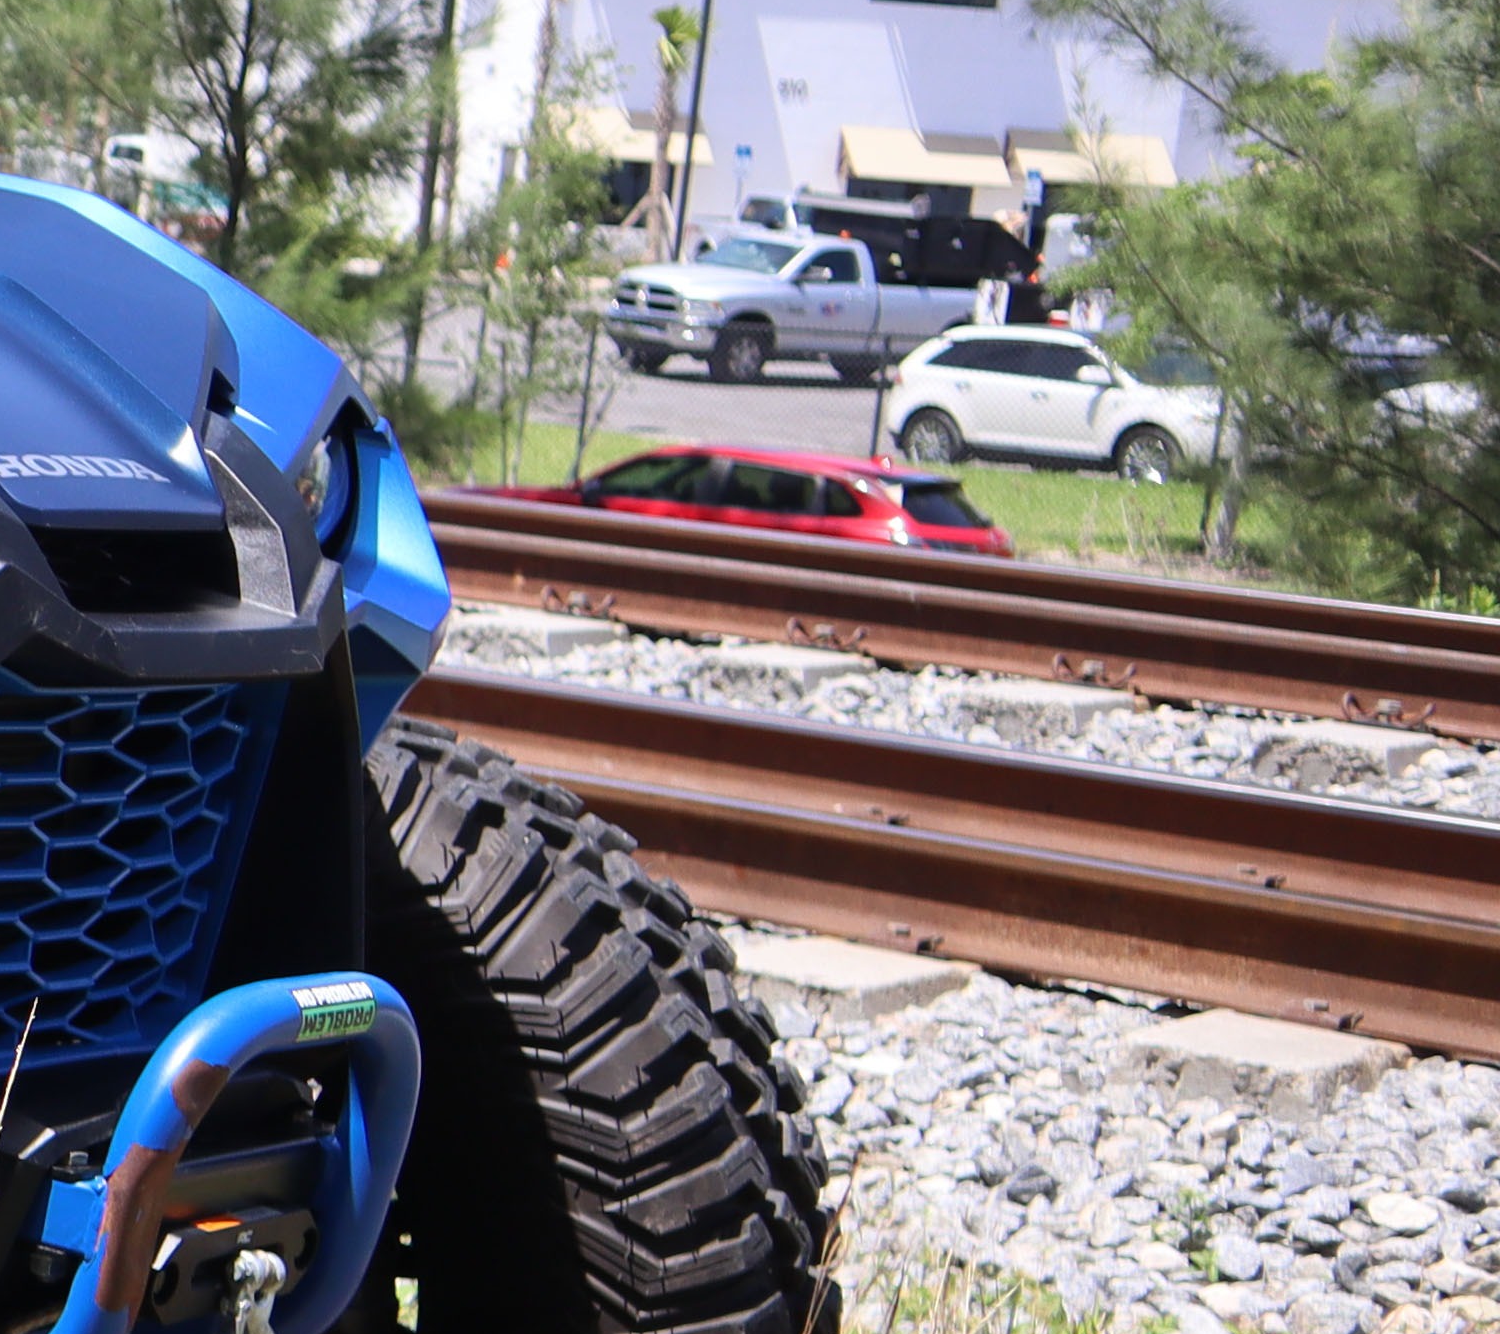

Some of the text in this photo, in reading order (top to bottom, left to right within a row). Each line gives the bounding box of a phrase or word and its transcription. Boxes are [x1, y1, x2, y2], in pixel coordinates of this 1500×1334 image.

[292, 981, 373, 1008] NO PROBLEM
[302, 1005, 374, 1034] PROBLEM
